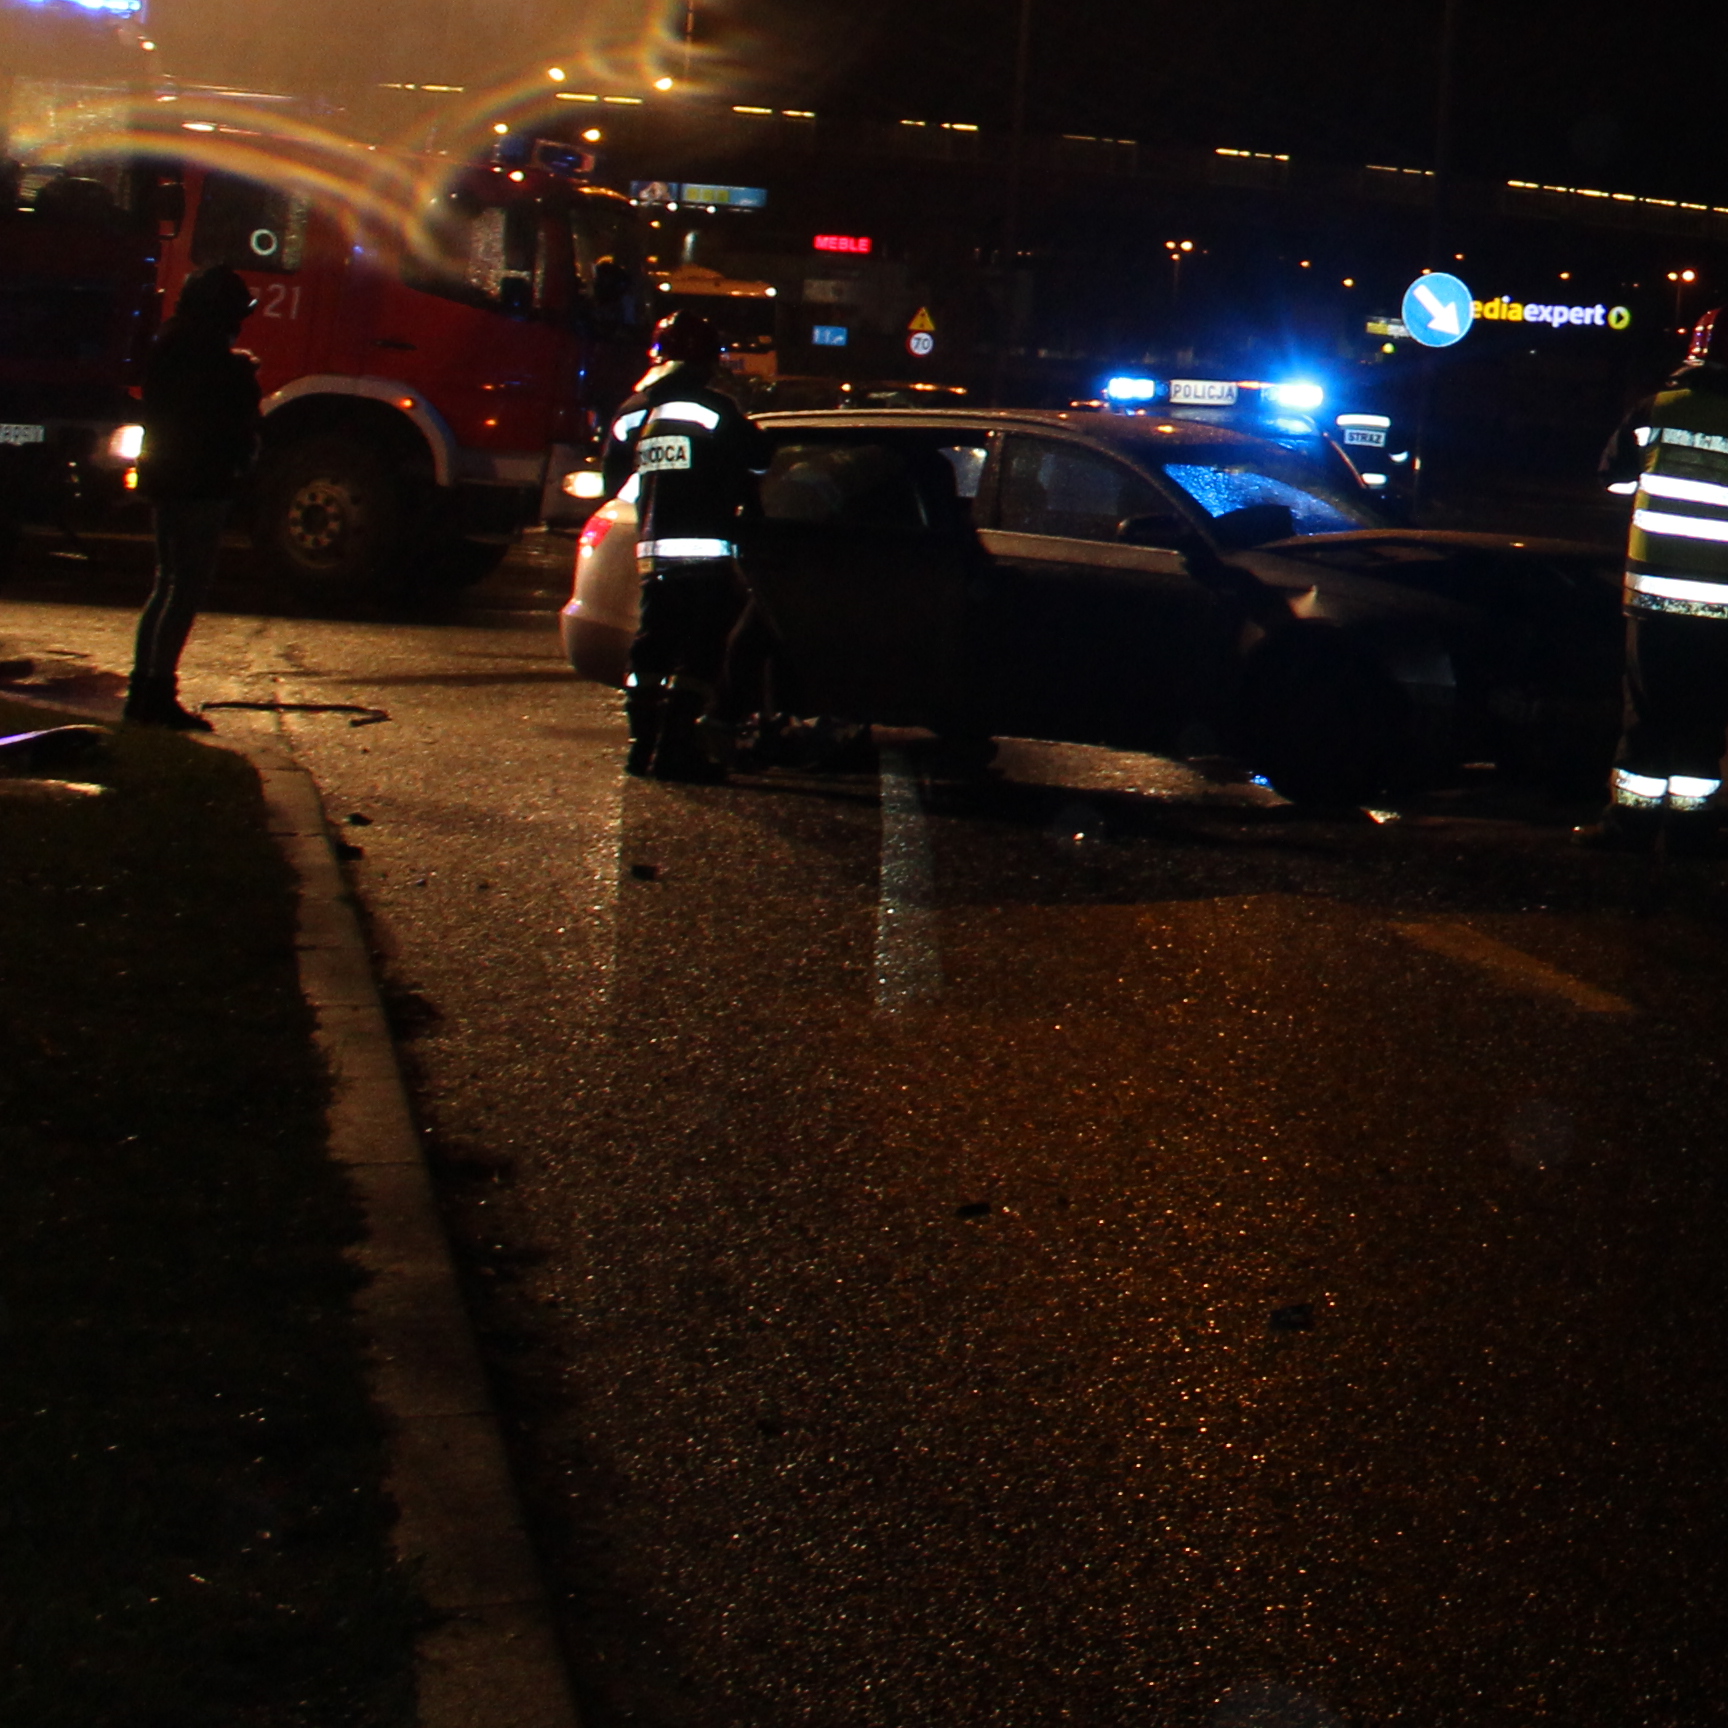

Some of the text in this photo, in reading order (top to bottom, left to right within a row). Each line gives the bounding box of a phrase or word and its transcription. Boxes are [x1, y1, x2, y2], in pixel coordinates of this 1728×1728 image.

[814, 235, 870, 253] MEBLE
[1469, 294, 1605, 328] ediaexpert
[912, 337, 931, 351] 70
[1173, 384, 1235, 399] POLICJA
